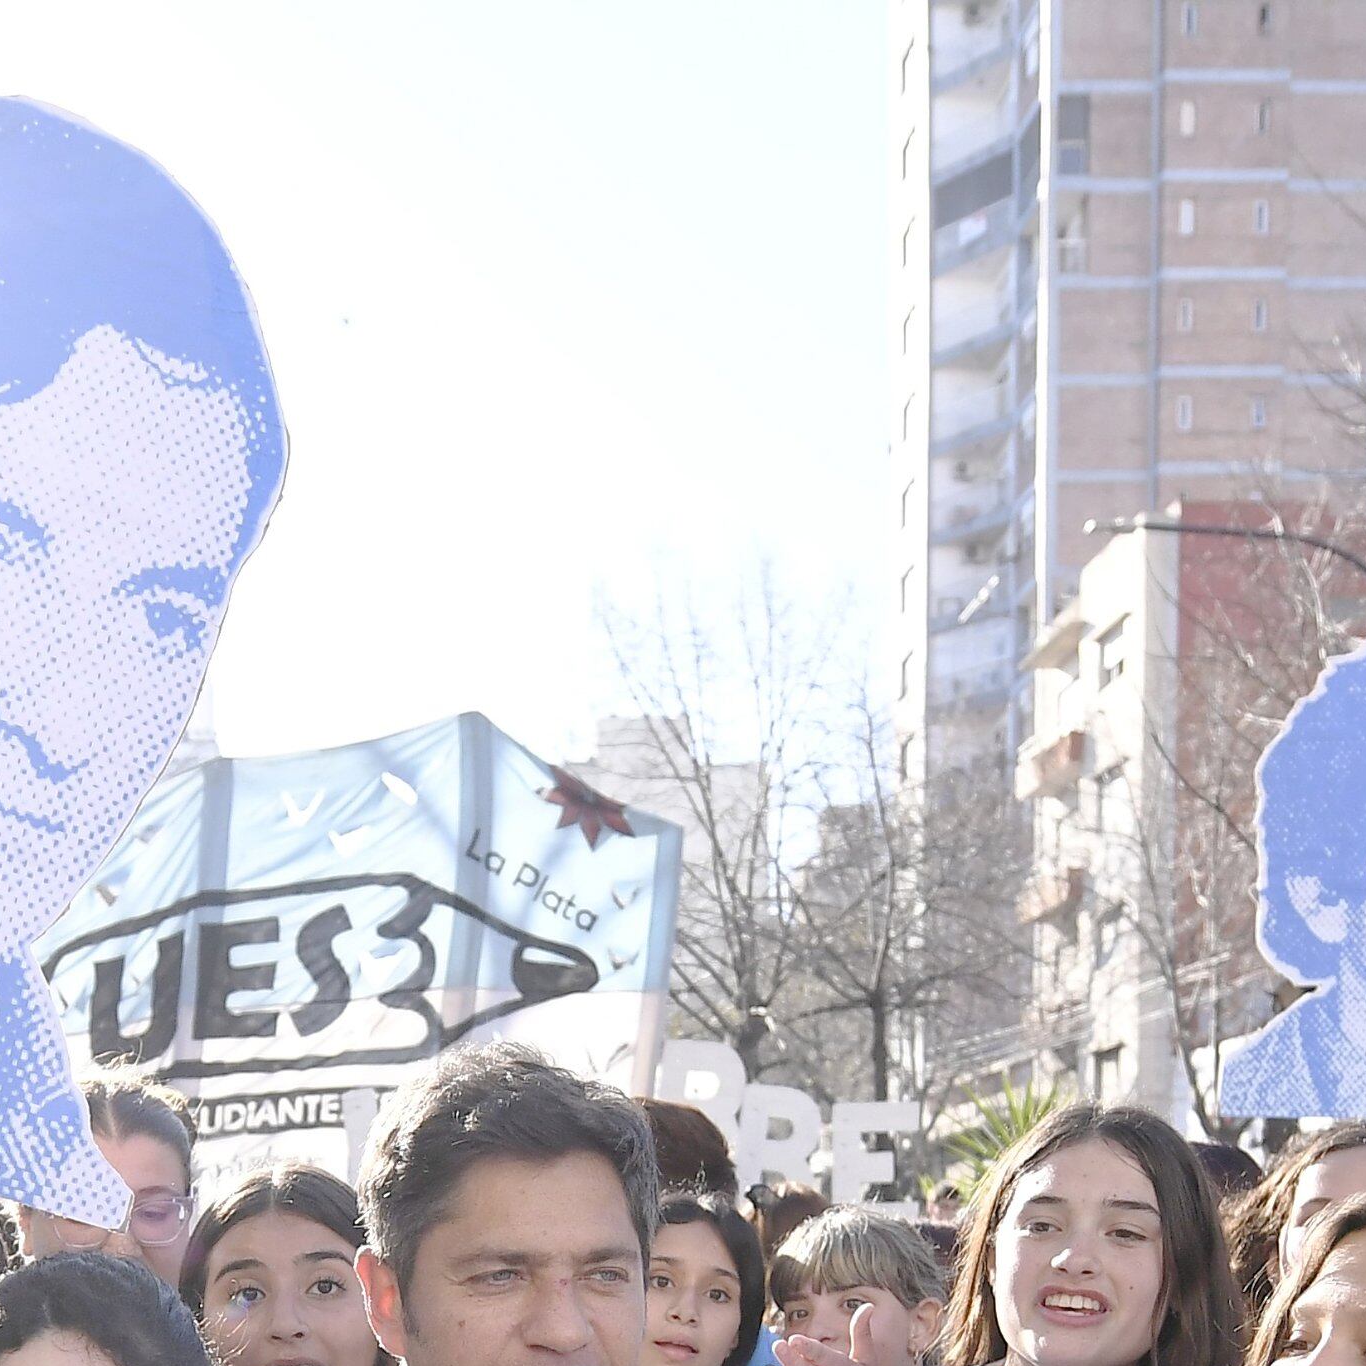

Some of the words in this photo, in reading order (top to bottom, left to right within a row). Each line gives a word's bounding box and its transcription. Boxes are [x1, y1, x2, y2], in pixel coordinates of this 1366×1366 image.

[464, 827, 503, 877] La
[513, 855, 598, 933] Plata
[199, 1093, 345, 1134] UDIANTE
